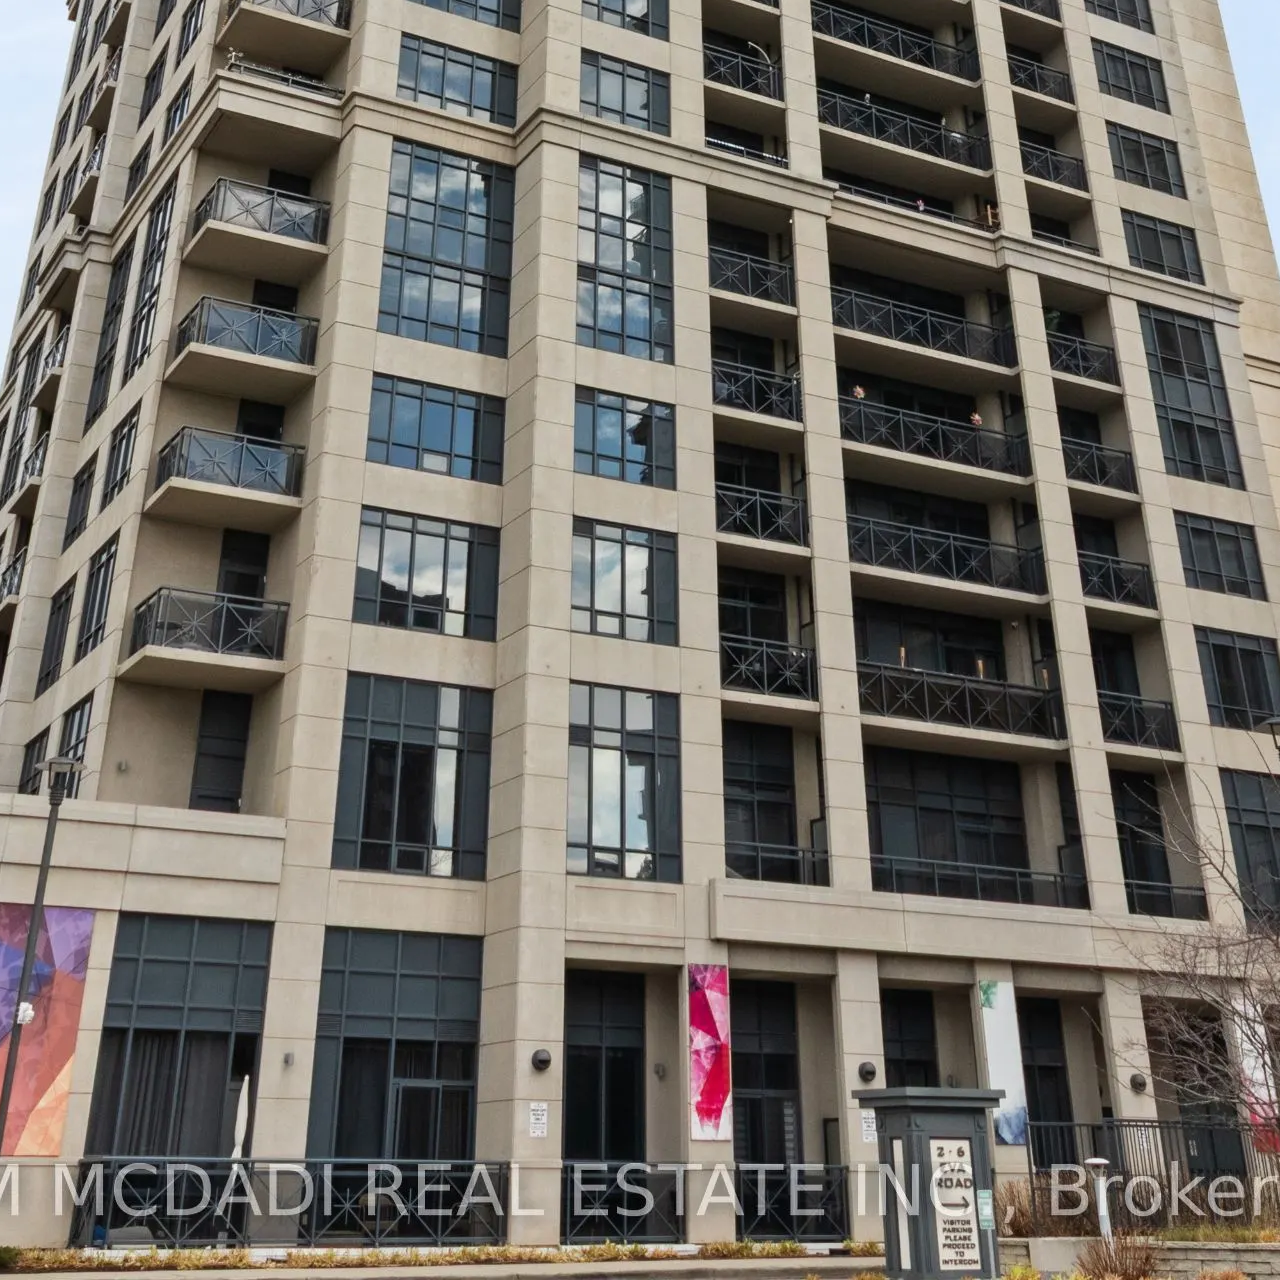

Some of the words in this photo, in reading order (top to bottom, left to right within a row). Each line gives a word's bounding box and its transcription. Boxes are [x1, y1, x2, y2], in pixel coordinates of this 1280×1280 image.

[937, 1177, 973, 1189] ROAD
[955, 1250, 965, 1258] TO
[942, 1258, 979, 1266] INTERCOM
